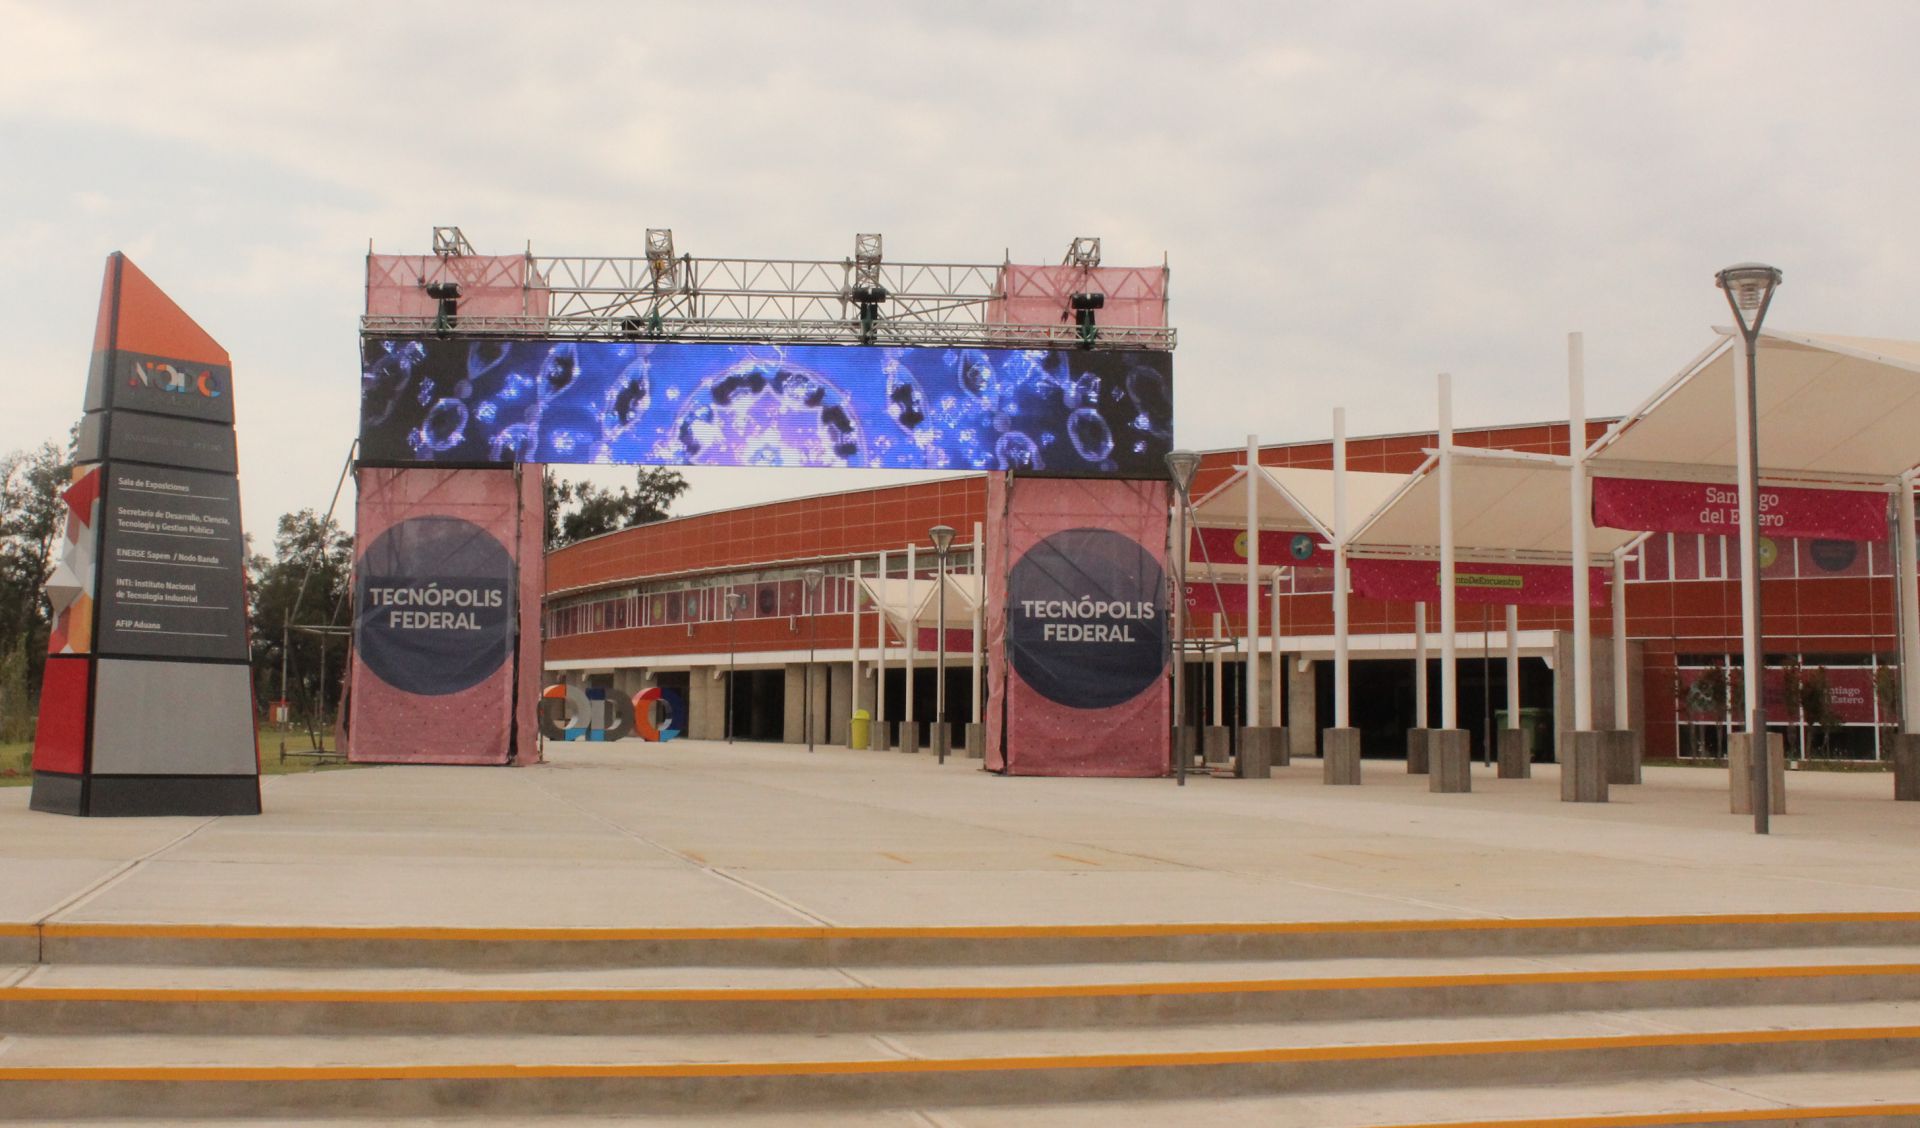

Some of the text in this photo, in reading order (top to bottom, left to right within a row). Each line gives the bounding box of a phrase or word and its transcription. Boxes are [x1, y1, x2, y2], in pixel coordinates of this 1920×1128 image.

[118, 477, 190, 492] Sala de Exposiciones
[1706, 487, 1779, 511] Sango
[155, 509, 164, 519] de
[1700, 508, 1784, 526] del Eero
[156, 524, 161, 532] y
[116, 548, 146, 558] ENERSE
[146, 551, 171, 560] Sapem
[173, 553, 178, 561] /
[178, 553, 196, 562] Nodo
[116, 577, 196, 591] INTI: Instituto Nacional
[1455, 575, 1521, 586] ntoDeEncuentro
[115, 590, 125, 599] de
[165, 594, 198, 603] Industrial
[369, 582, 503, 607] TECNÓPOLIS
[1021, 594, 1155, 619] TECNÓPOLIS
[115, 619, 161, 629] AFIP Aduana
[389, 611, 482, 630] FEDERAL
[1043, 623, 1136, 642] FEDERAL
[1824, 685, 1861, 697] ntiago
[1831, 695, 1864, 704] Estero
